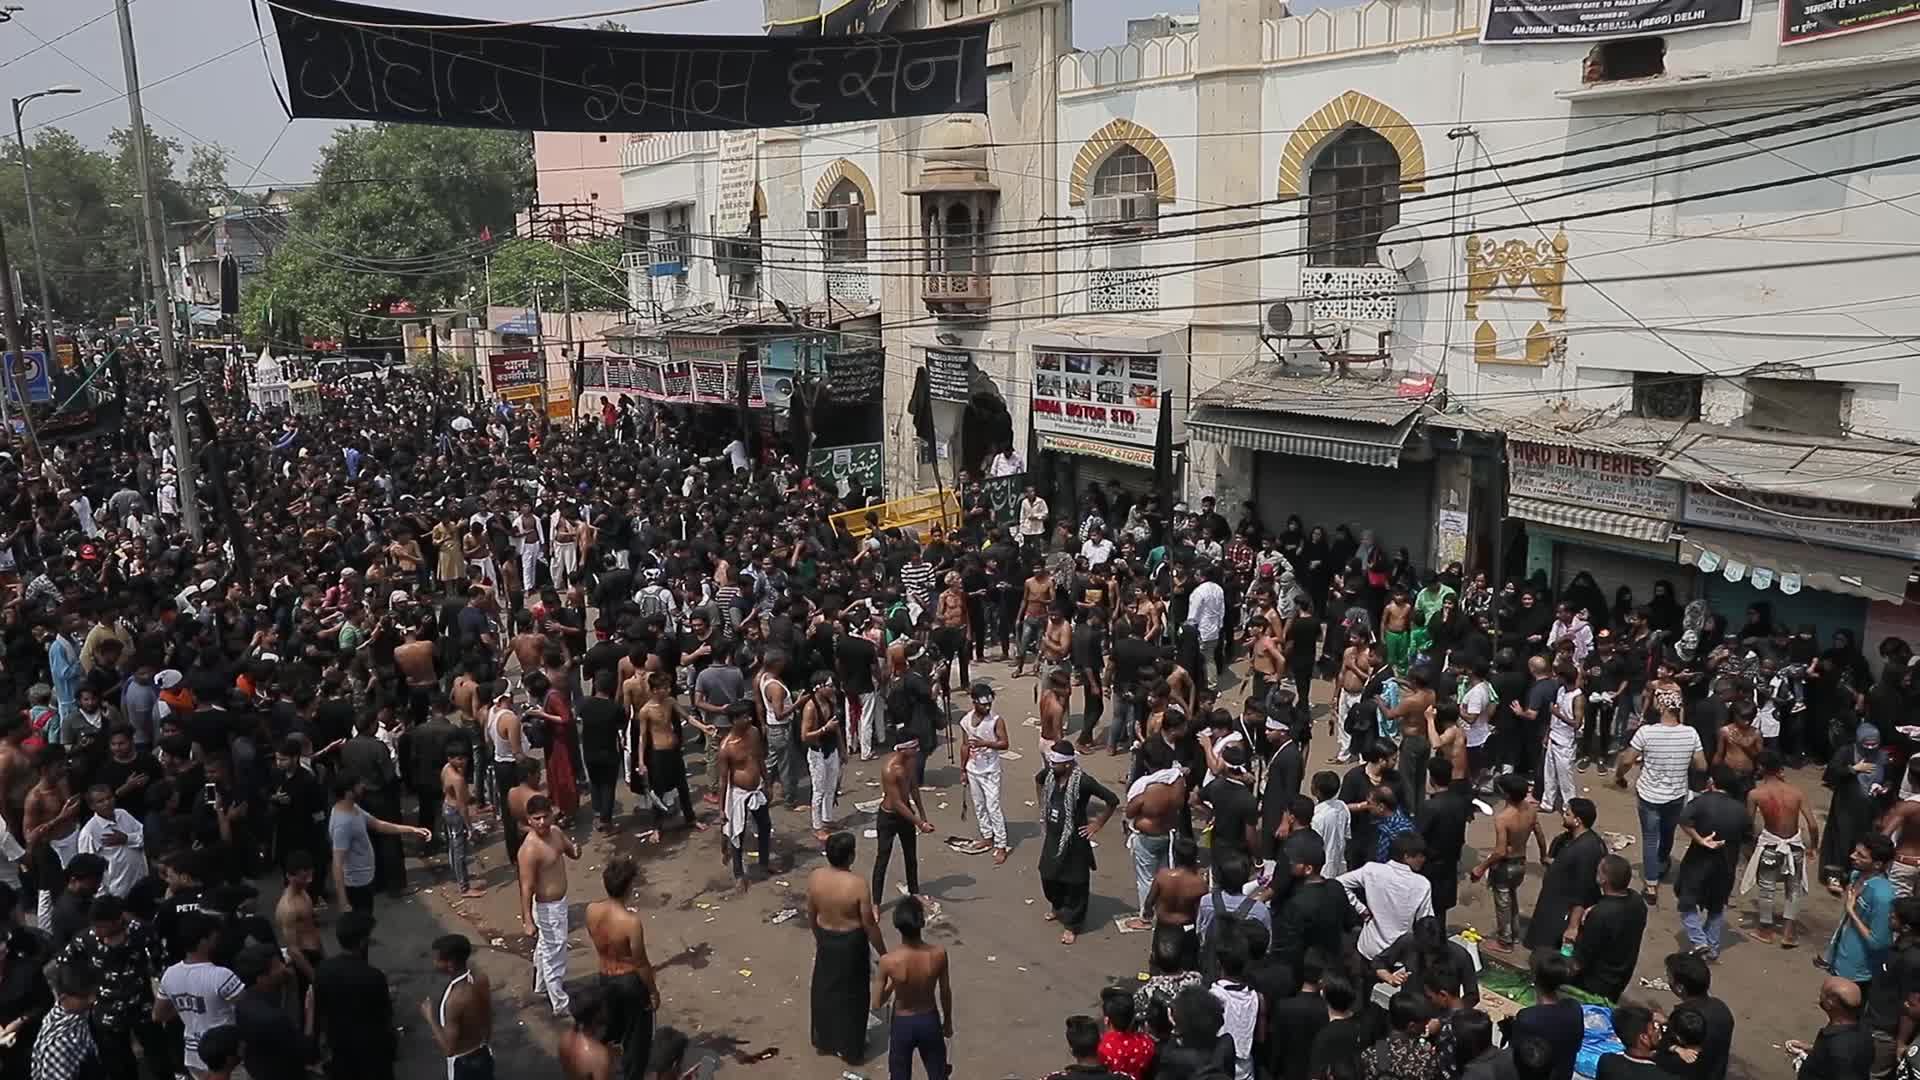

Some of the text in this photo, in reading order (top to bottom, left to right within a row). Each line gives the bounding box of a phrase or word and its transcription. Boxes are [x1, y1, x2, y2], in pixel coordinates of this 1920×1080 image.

[1674, 10, 1705, 22] DELHI
[1115, 450, 1153, 464] STORES
[1557, 446, 1653, 477] BATTERIES
